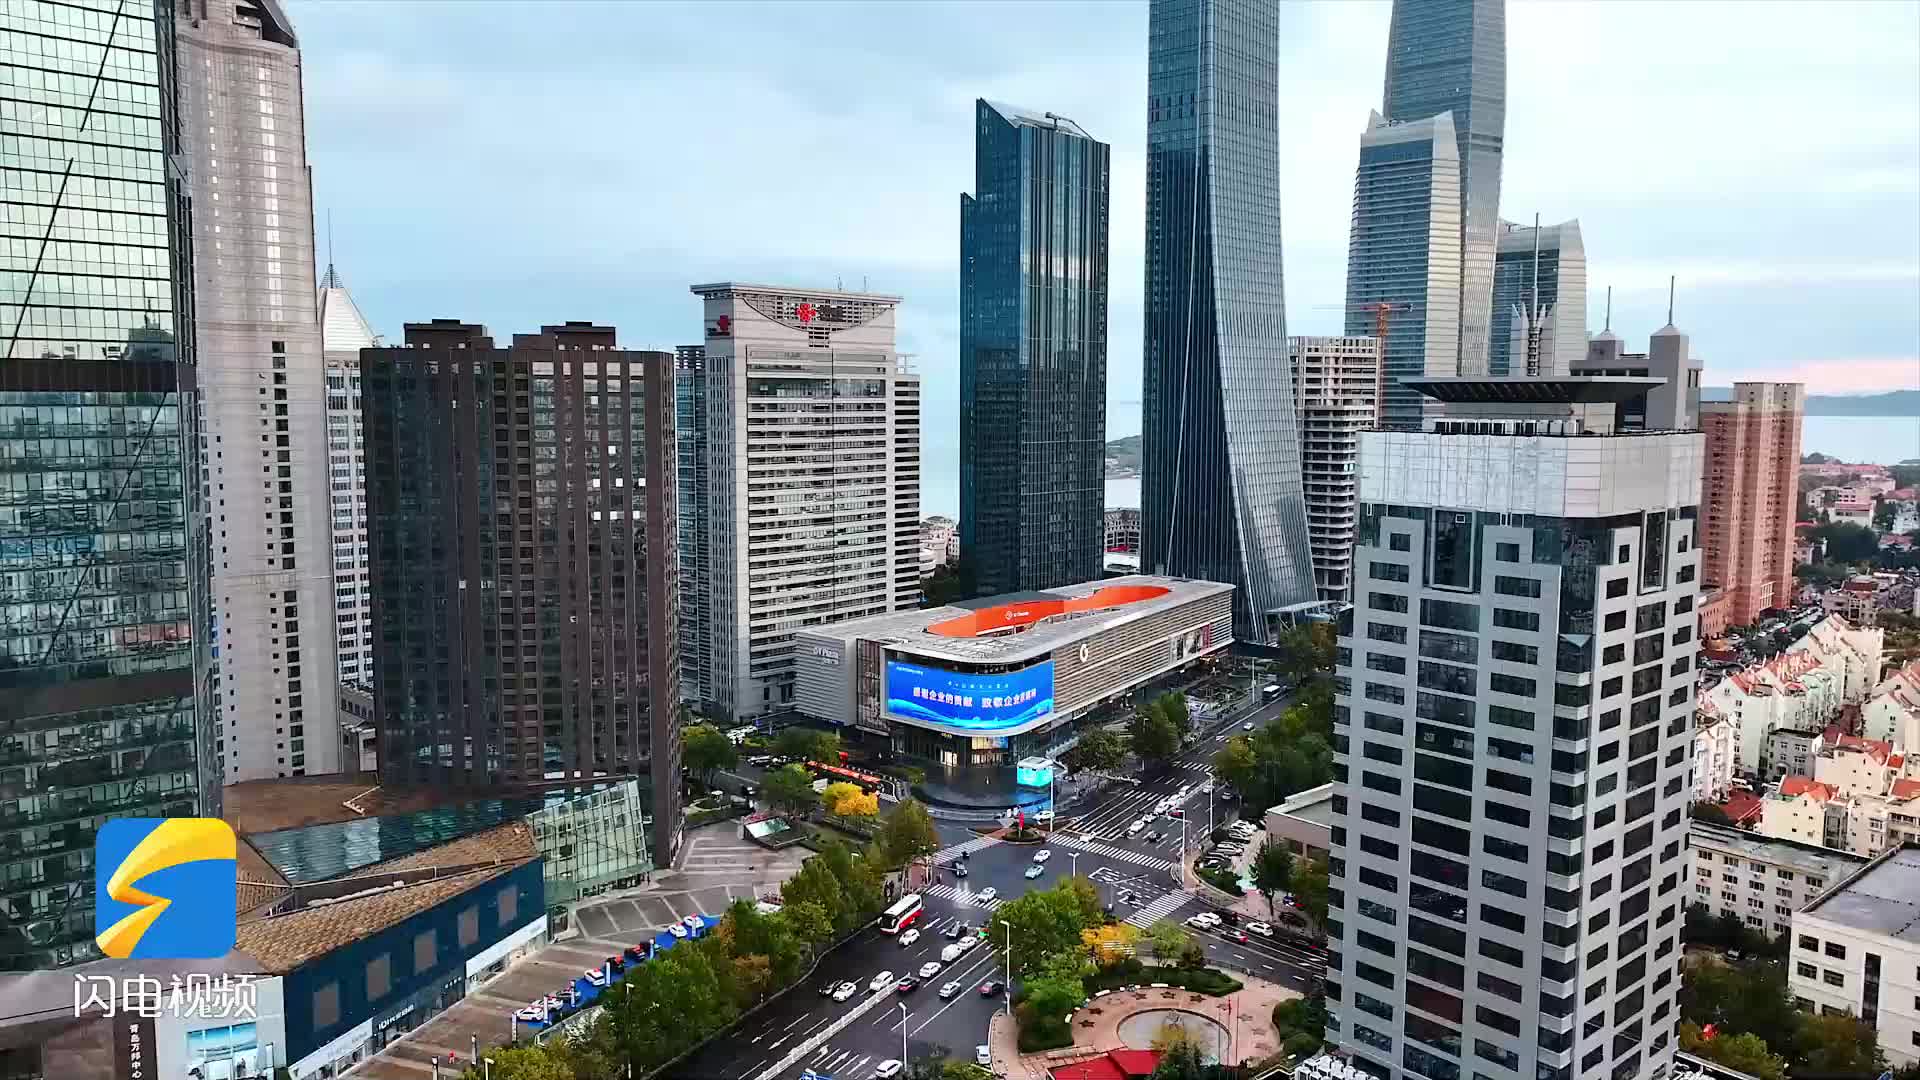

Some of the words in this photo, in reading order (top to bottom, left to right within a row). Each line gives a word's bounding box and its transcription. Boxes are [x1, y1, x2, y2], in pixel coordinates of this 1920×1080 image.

[129, 1023, 143, 1079] 青岛万邦中心
